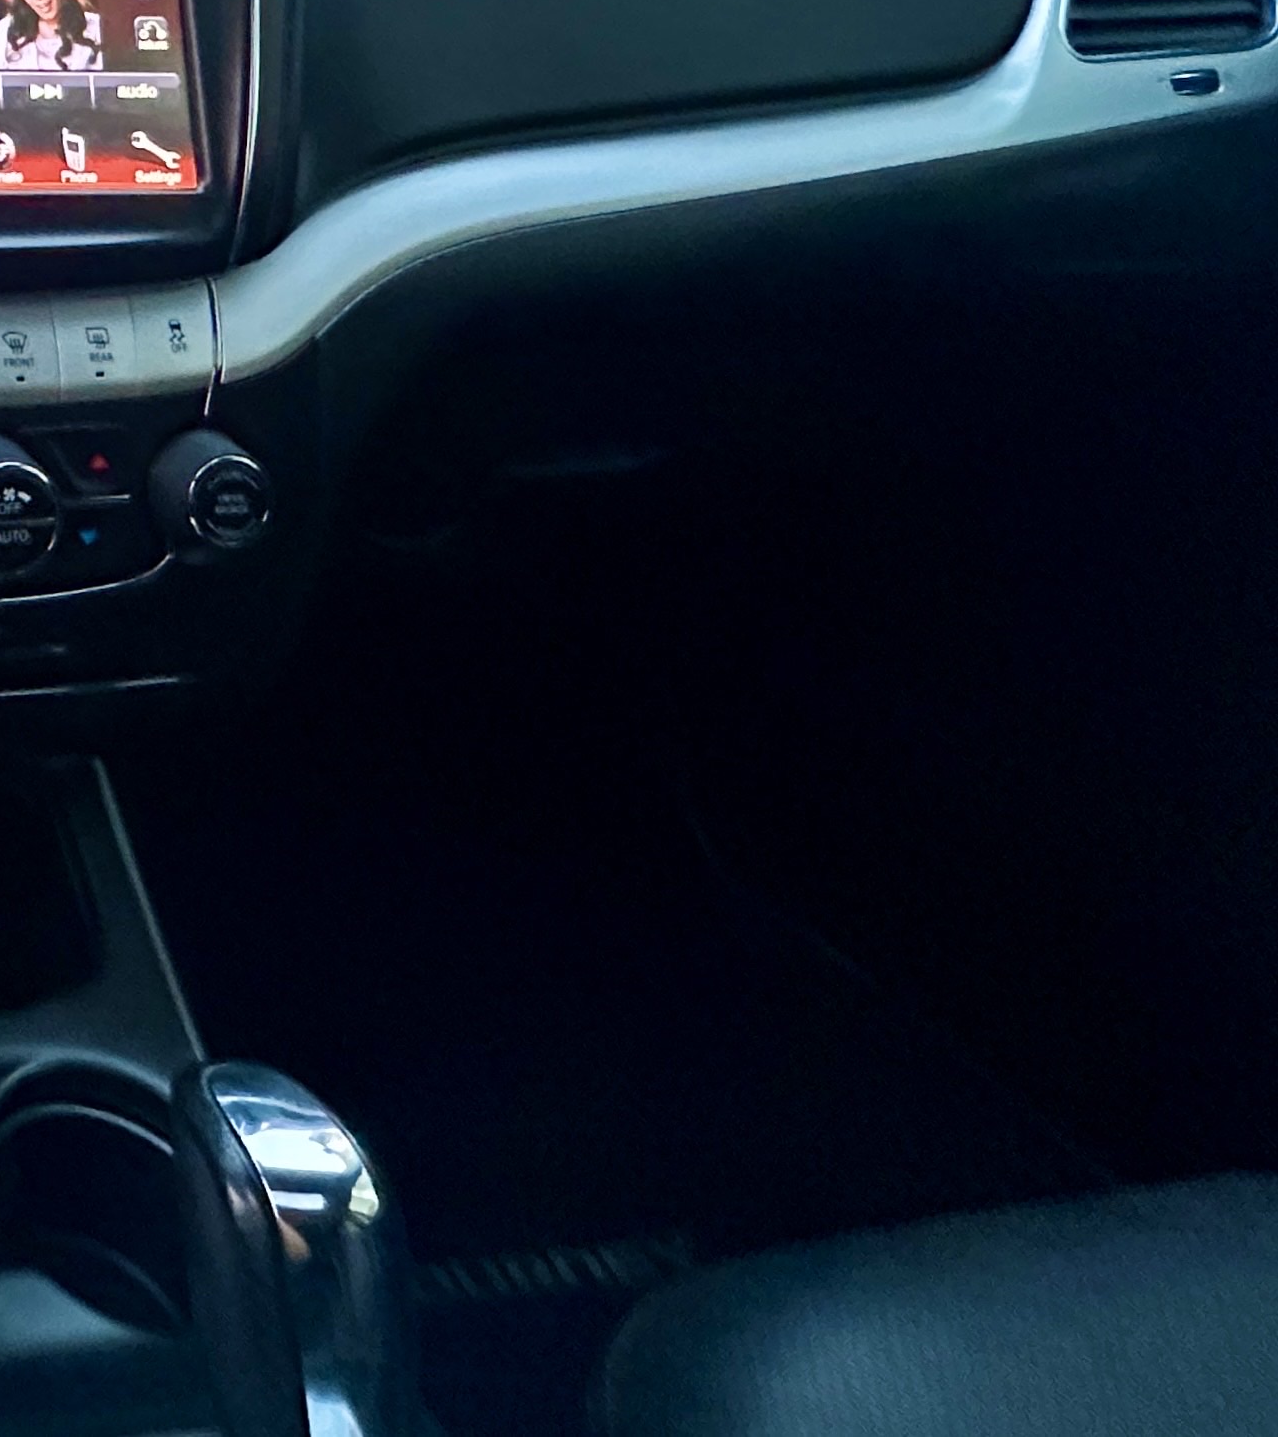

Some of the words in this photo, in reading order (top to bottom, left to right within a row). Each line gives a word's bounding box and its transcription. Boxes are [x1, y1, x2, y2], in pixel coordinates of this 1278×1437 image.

[117, 84, 158, 99] audio
[61, 170, 98, 184] Phone
[135, 170, 182, 186] Settings
[3, 358, 35, 368] FRONT
